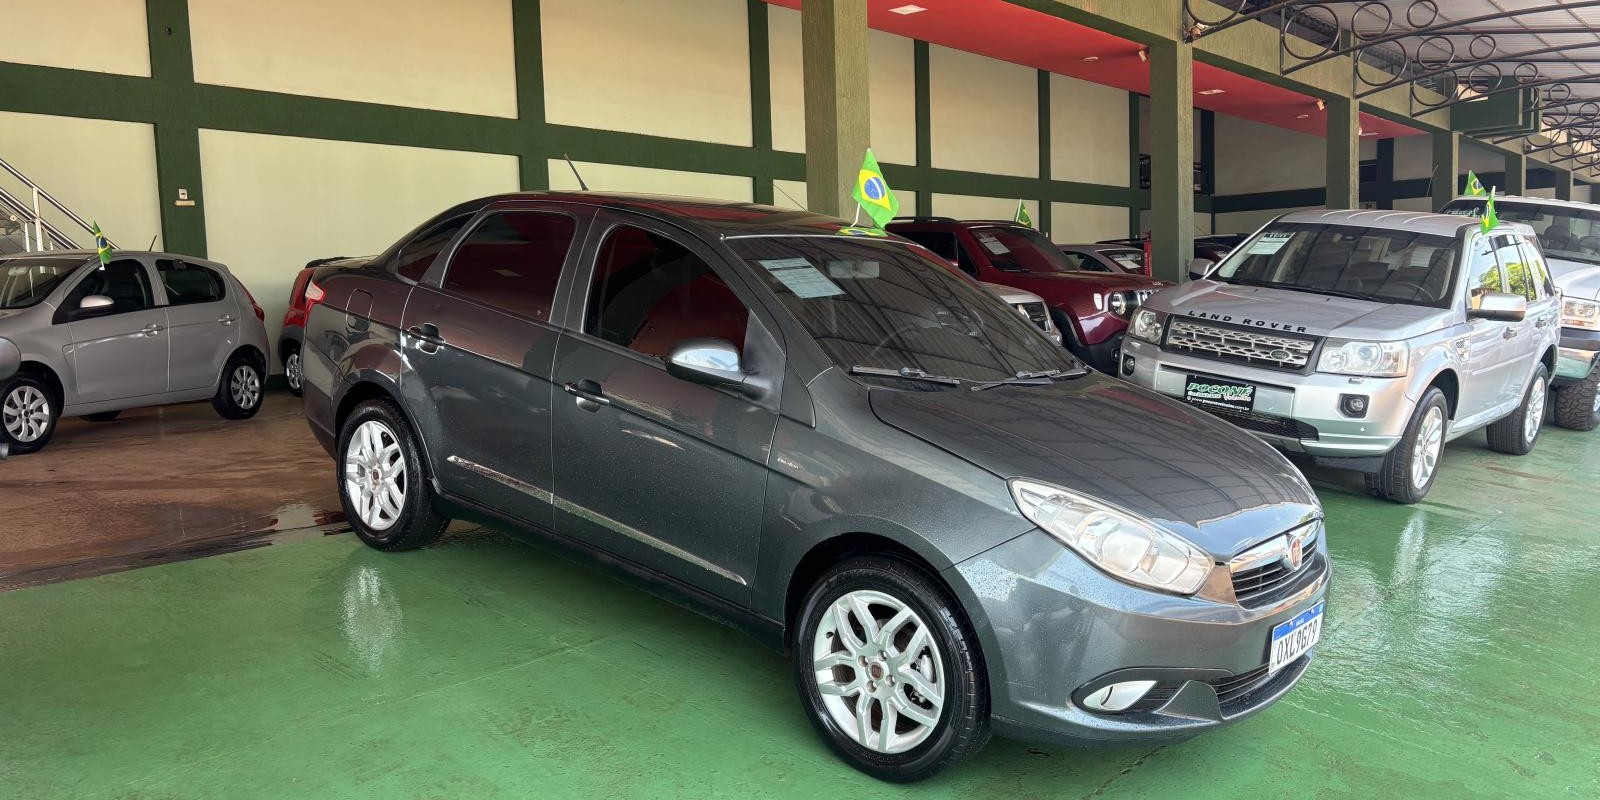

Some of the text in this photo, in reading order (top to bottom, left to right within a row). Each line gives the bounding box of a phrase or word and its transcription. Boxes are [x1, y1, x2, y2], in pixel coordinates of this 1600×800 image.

[1188, 310, 1307, 333] LAND ROVER
[1187, 382, 1253, 397] POCONÉ
[1276, 618, 1318, 665] OXL9G79
